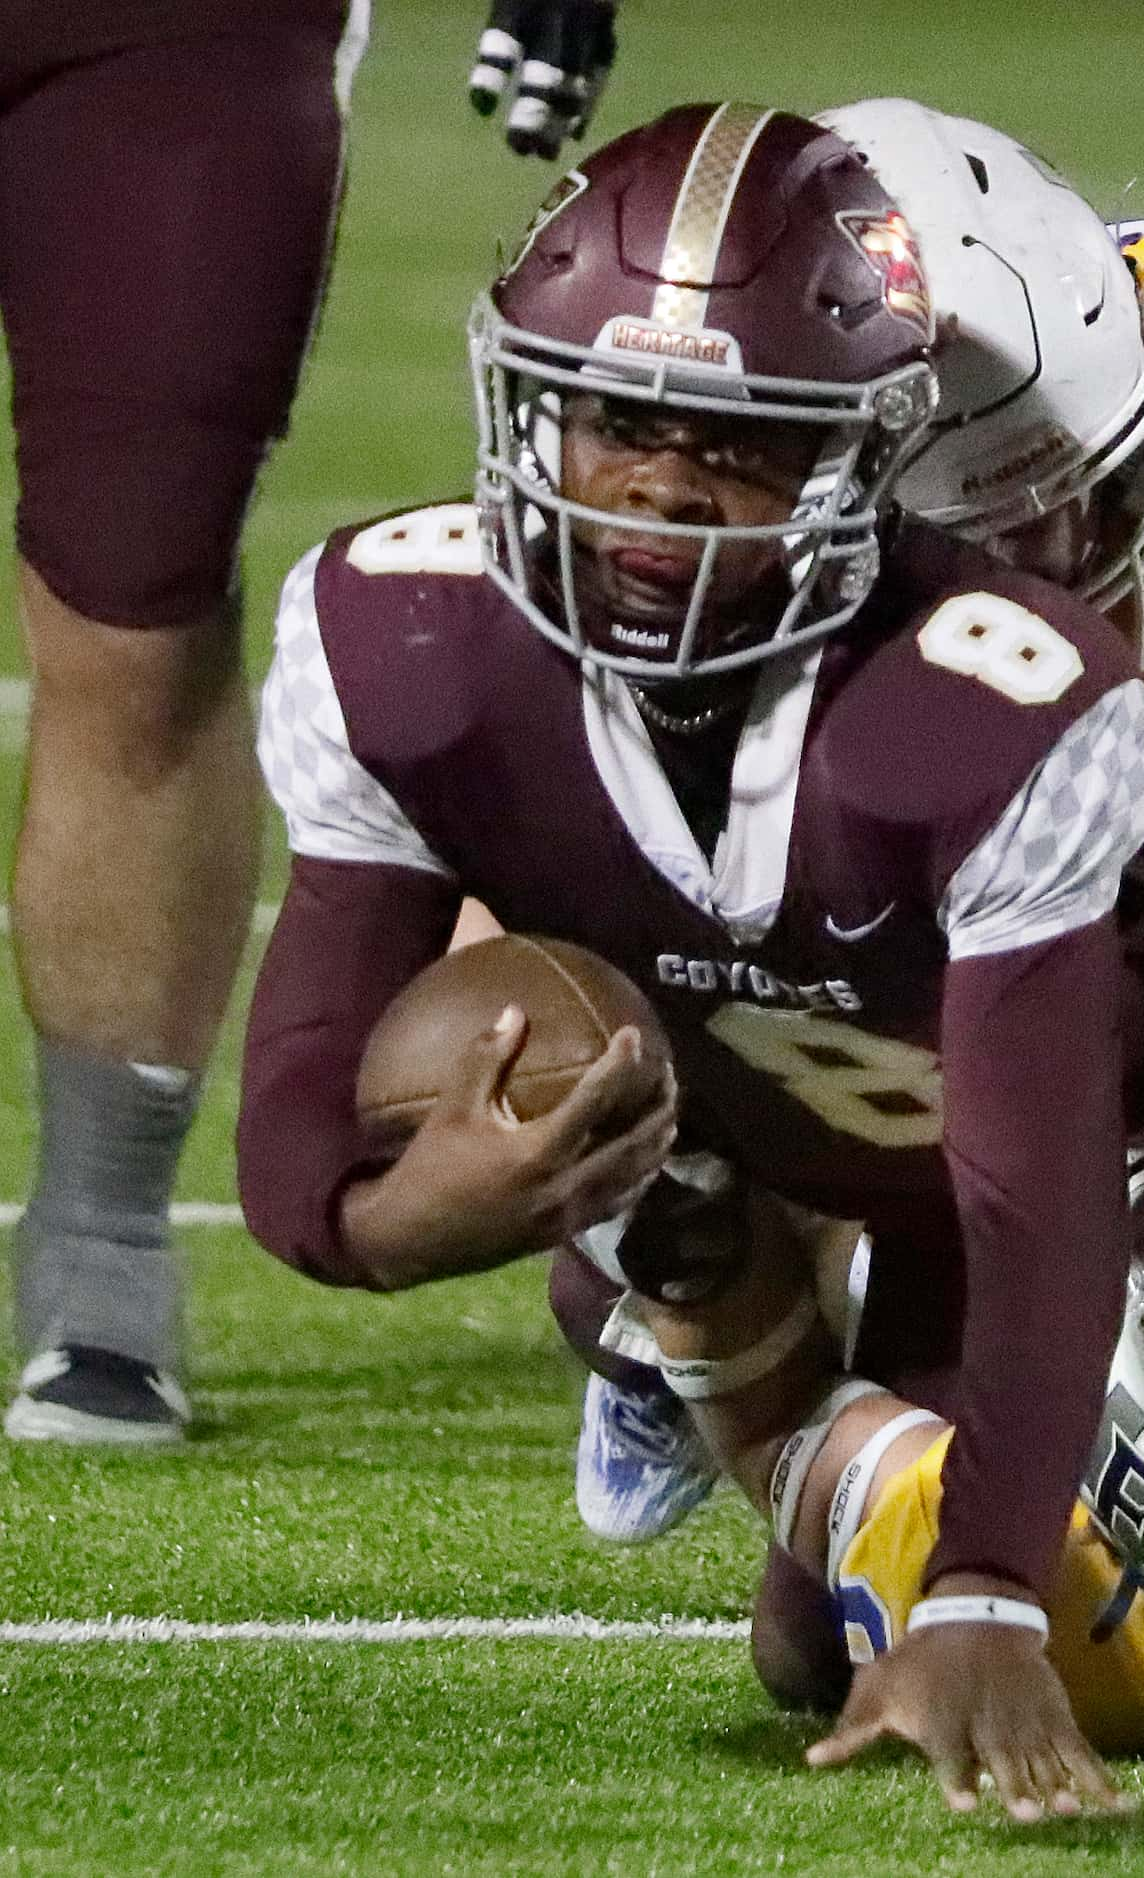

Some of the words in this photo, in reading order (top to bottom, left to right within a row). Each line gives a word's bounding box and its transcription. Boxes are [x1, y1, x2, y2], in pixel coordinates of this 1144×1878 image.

[346, 503, 486, 575] 8
[917, 590, 1085, 705] 8
[705, 1001, 945, 1148] 8
